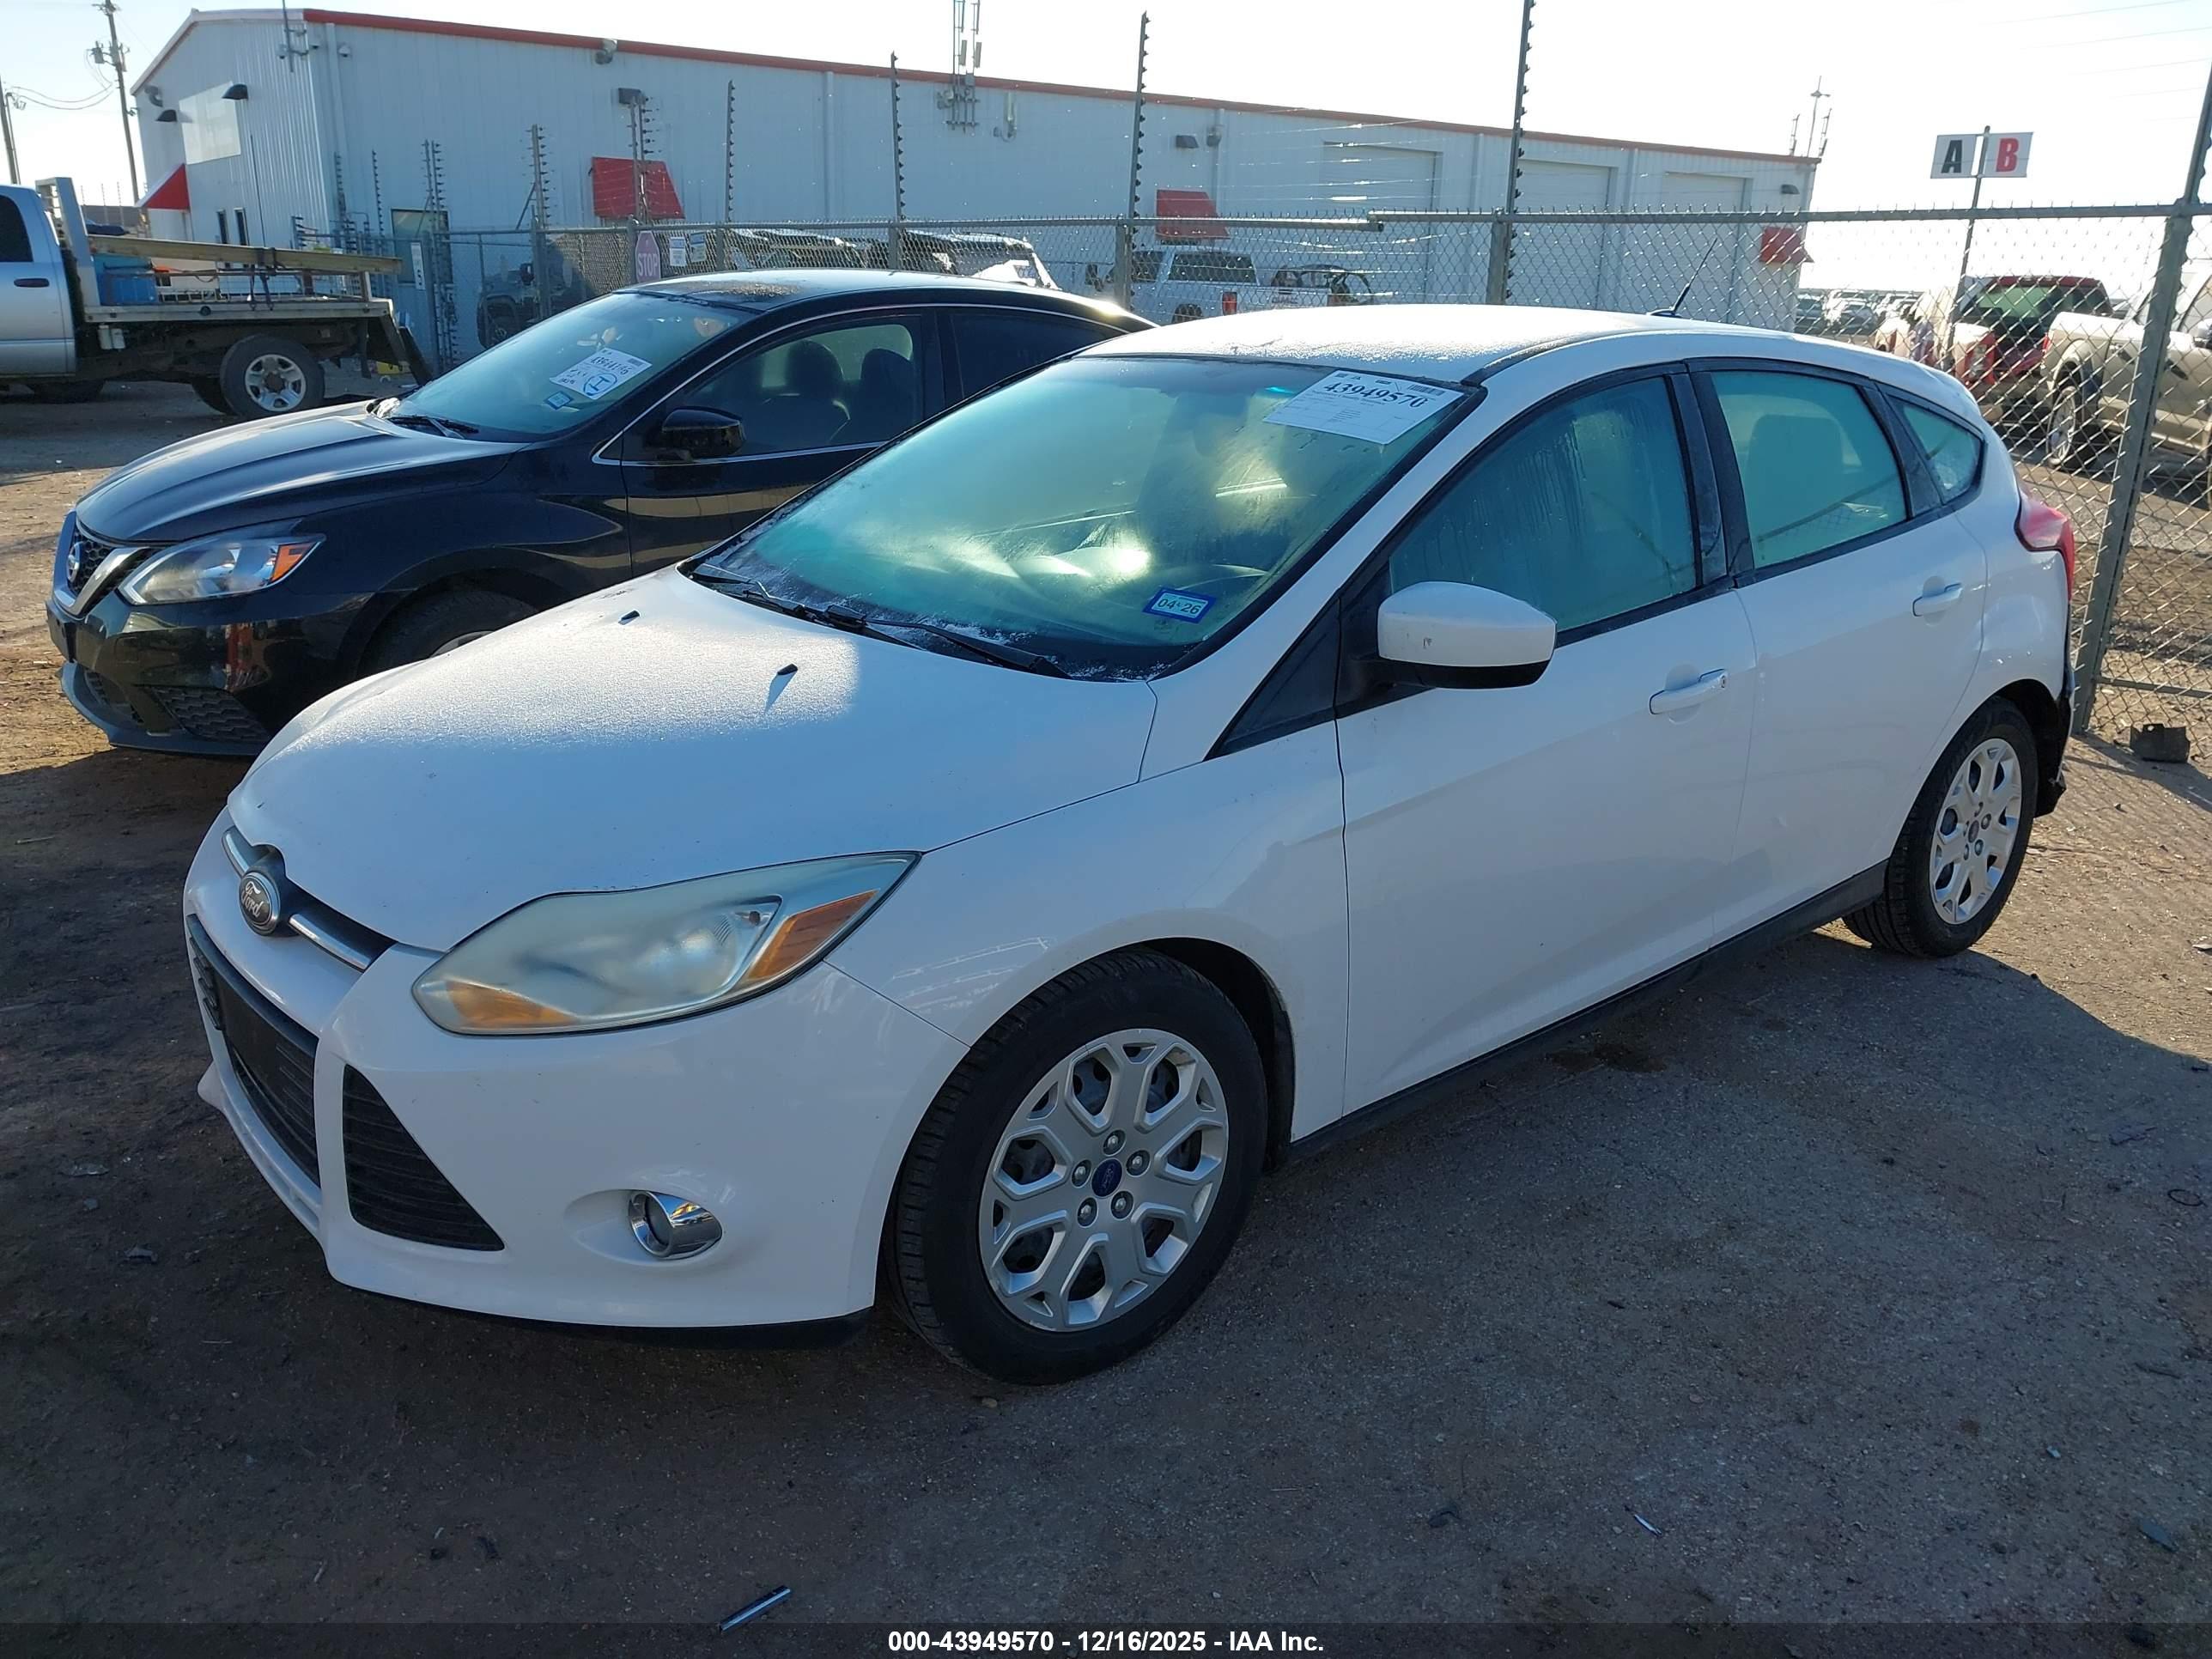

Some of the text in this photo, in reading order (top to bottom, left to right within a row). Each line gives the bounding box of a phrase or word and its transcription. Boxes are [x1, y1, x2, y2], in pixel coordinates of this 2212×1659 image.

[1941, 137, 2020, 173] A B
[638, 252, 658, 276] STOP
[1324, 382, 1428, 408] 43949570
[1158, 599, 1201, 614] 04 26
[241, 881, 264, 918] Ford
